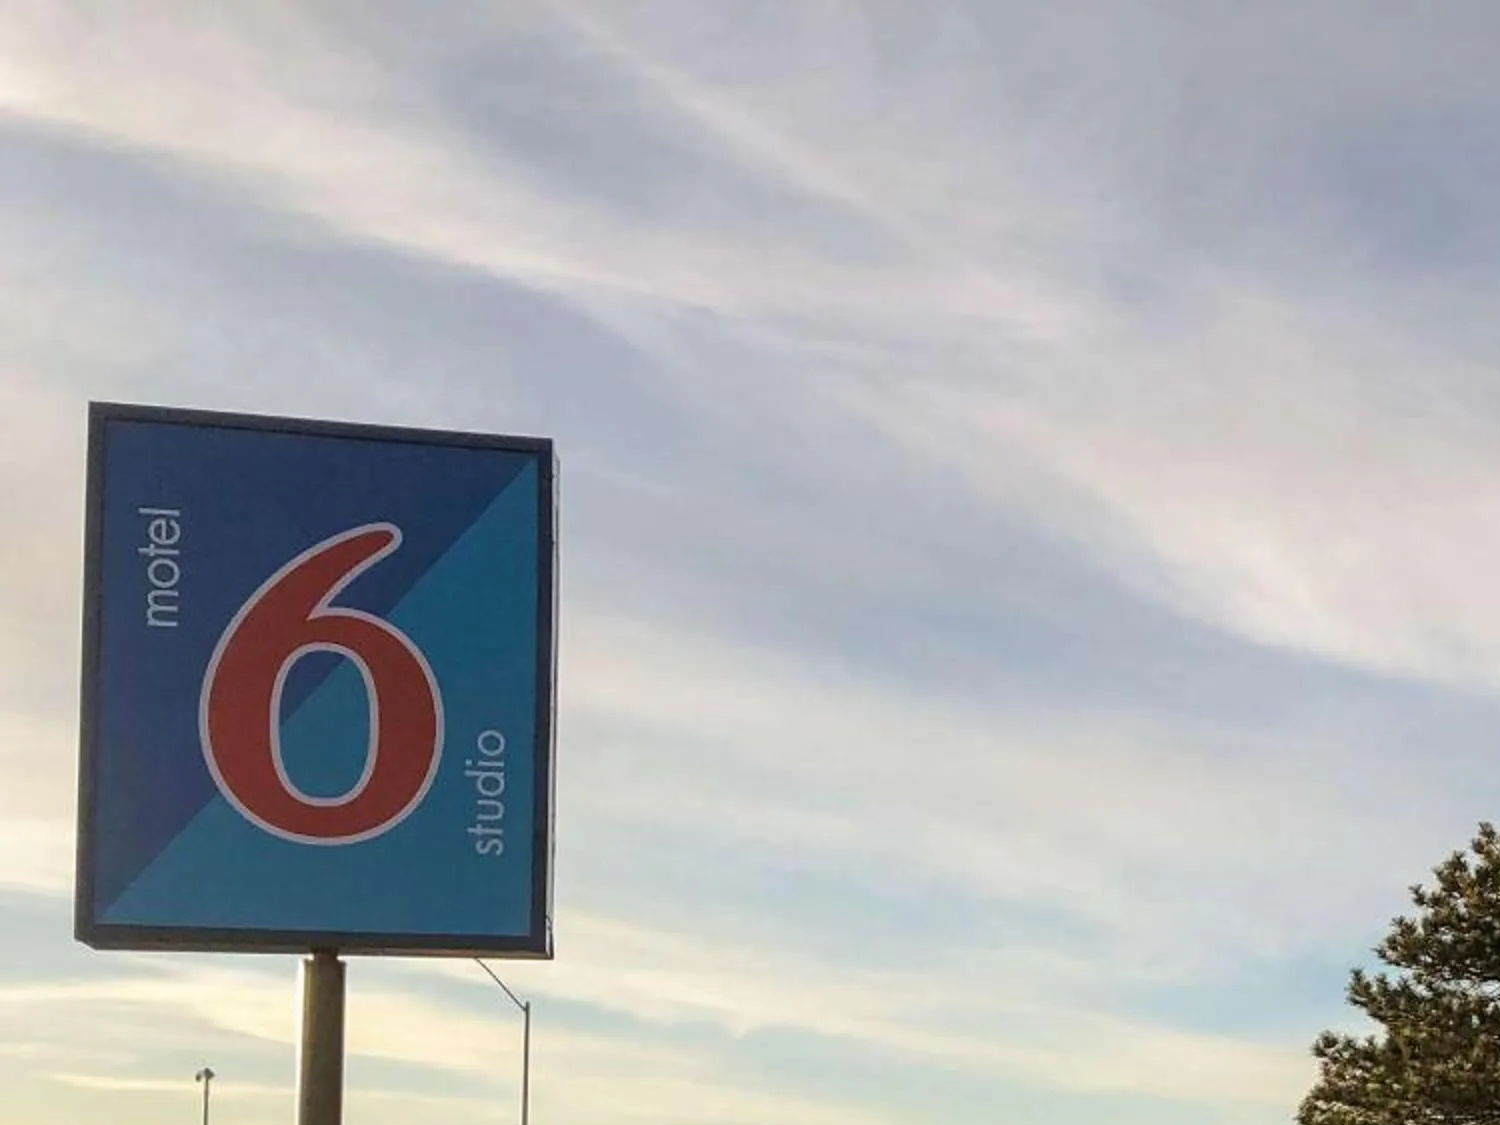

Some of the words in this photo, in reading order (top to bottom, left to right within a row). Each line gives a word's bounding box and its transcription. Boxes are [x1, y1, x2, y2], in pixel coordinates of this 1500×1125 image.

[138, 506, 181, 628] motel
[199, 521, 445, 846] 6
[463, 729, 506, 855] studio
